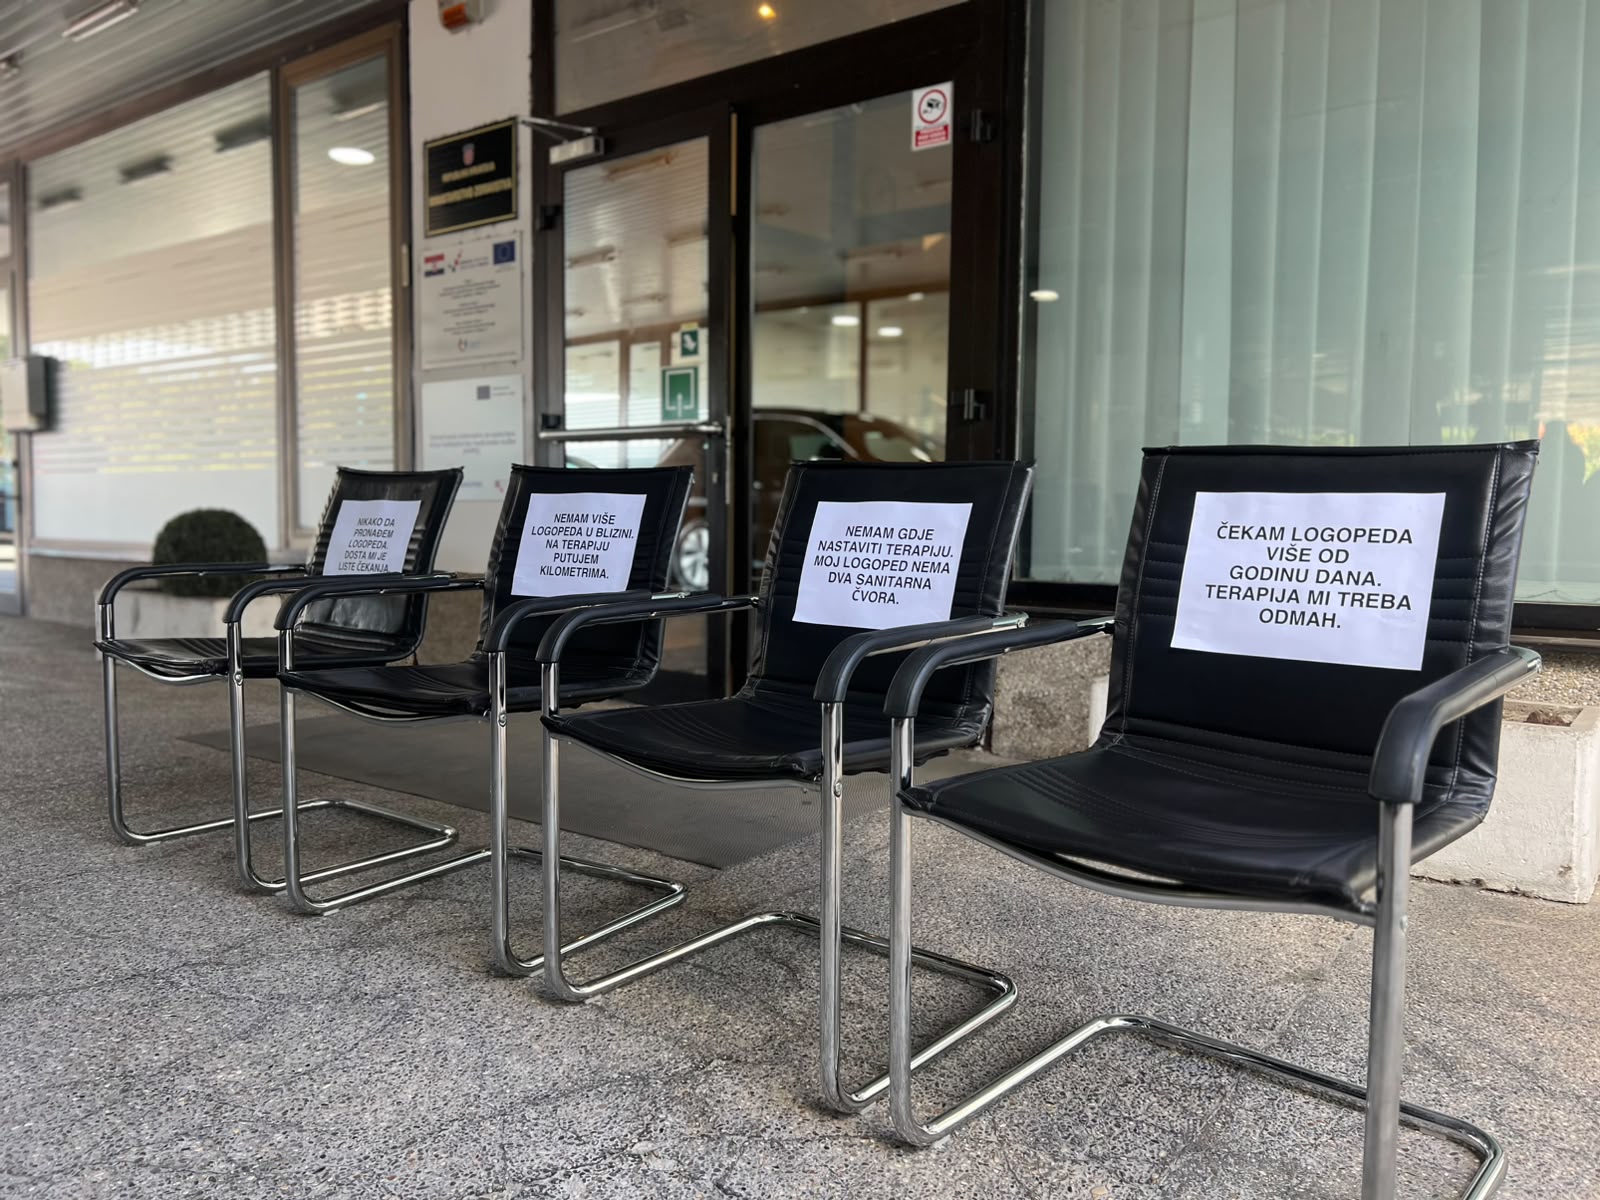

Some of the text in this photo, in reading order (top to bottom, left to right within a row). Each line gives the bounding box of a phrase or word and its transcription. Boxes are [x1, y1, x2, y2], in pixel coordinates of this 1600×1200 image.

[357, 517, 396, 527] NIKAKO DA
[553, 512, 616, 525] NEMAM VIŠE
[353, 528, 394, 538] PRONAĐEM
[531, 526, 634, 539] LOGOPEDA U BLIZINI.
[845, 525, 935, 541] NEMAM GDJE
[1216, 521, 1413, 544] ČEKAM LOGOPEDA
[348, 539, 389, 549] LOGOPEDA.
[545, 539, 610, 551] NA TERAPIJU
[817, 540, 954, 558] NASTAVITI TERAPIJU.
[344, 550, 388, 561] DOSTA MI JE
[553, 553, 599, 564] PUTUJEM
[1266, 543, 1350, 564] VIŠE OD
[338, 561, 356, 571] LISTE
[540, 565, 609, 579] KILOMETRIMA.
[814, 555, 950, 574] MOJ LOGOPED NEMA
[828, 571, 932, 590] DVA SANITARNA
[1229, 565, 1382, 587] GODINU DANA.
[852, 586, 899, 605] ČVORA.
[1205, 584, 1412, 611] TERAPIJA MI TREBA
[1258, 608, 1341, 629] ODMAH.
